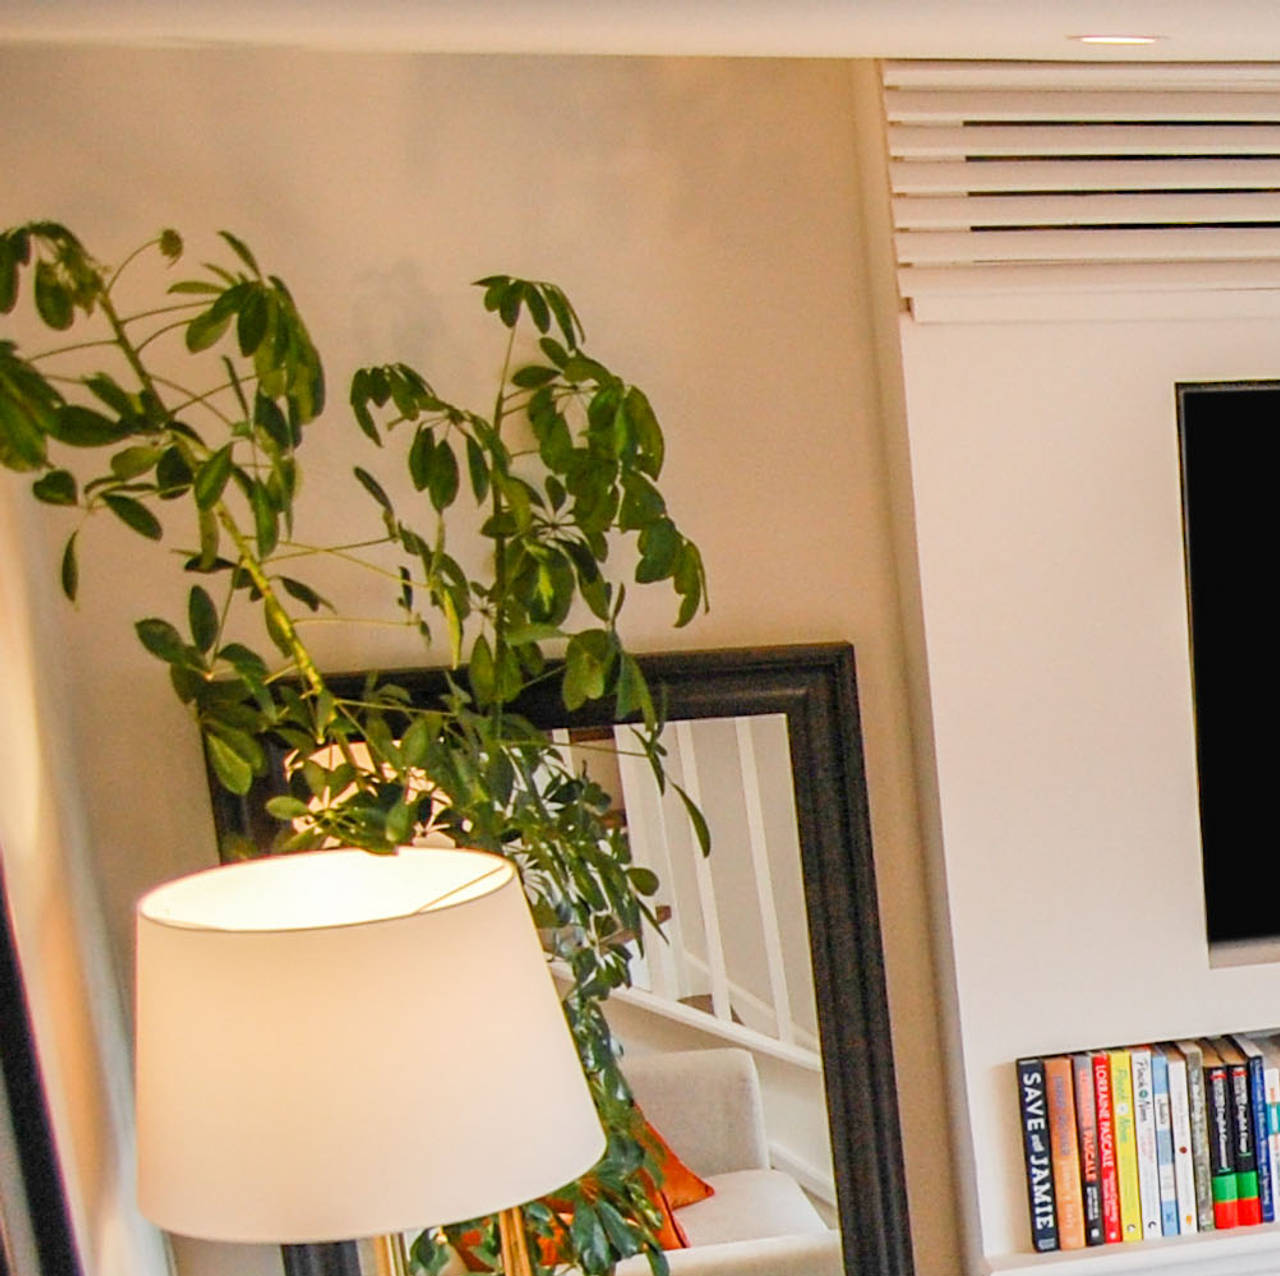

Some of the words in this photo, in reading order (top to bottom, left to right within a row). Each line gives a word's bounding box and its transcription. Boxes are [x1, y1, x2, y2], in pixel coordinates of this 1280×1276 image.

[1023, 1071, 1045, 1131] SAVE
[1095, 1064, 1109, 1119] LORRAINE
[1082, 1129, 1096, 1182] PASCALE
[1099, 1121, 1112, 1167] PASCALE
[1029, 1154, 1054, 1229] JAMIE
